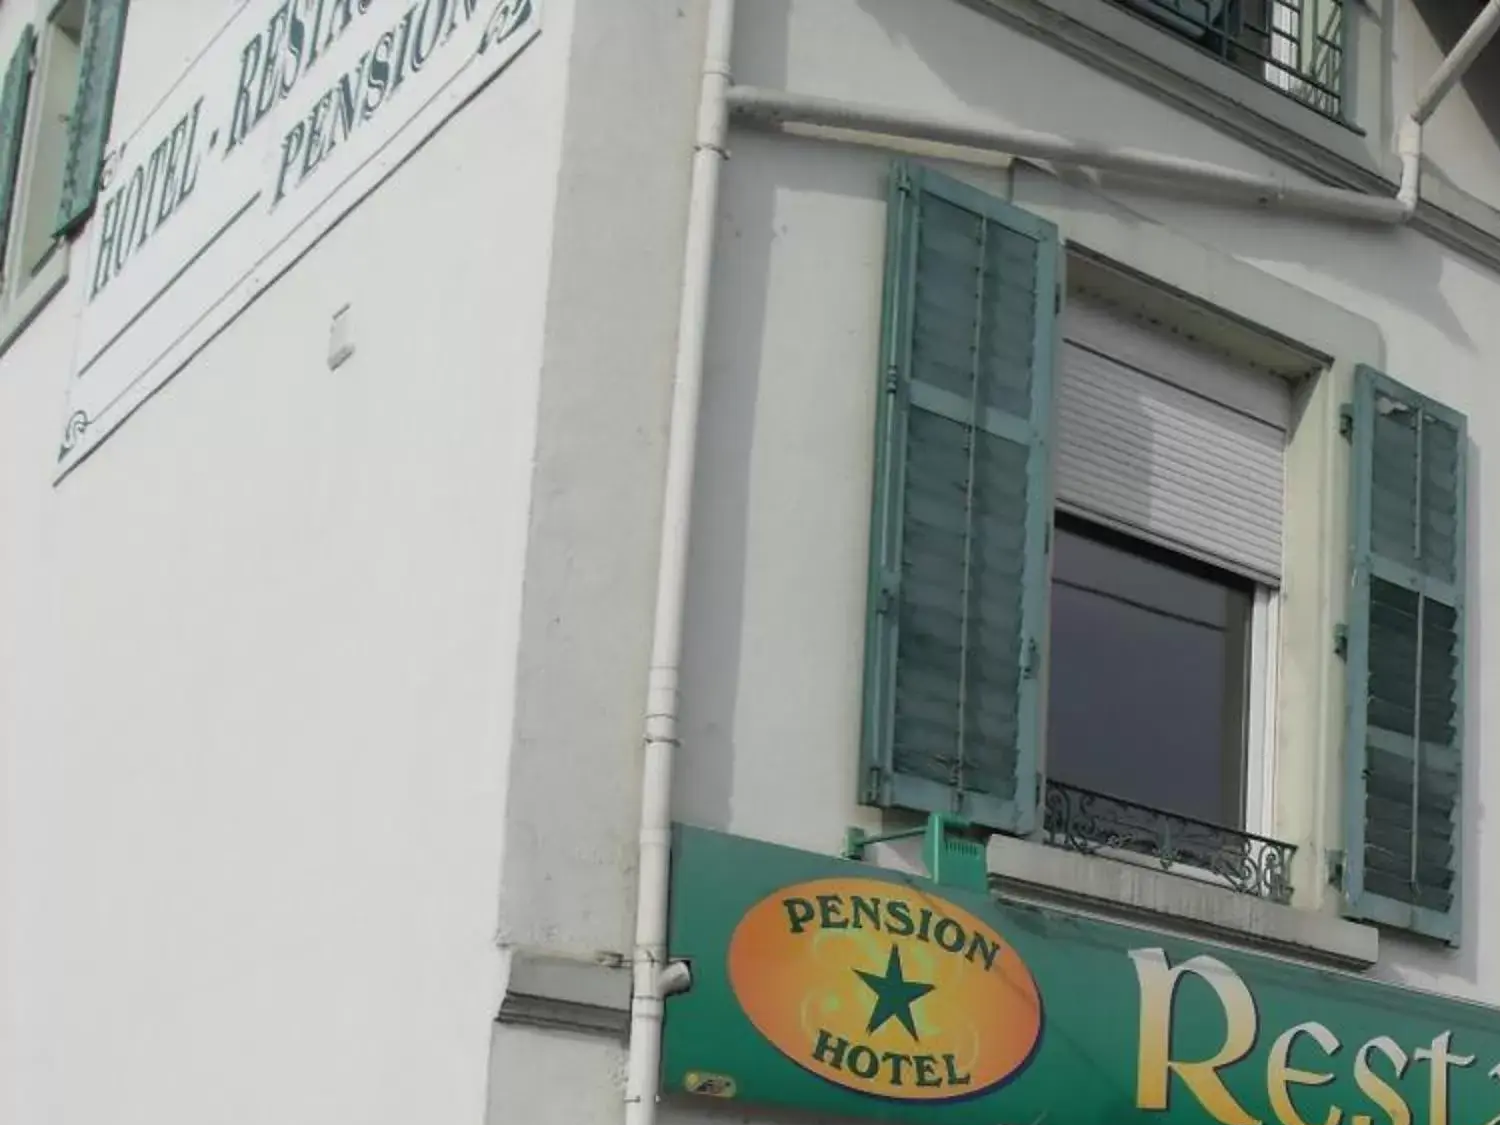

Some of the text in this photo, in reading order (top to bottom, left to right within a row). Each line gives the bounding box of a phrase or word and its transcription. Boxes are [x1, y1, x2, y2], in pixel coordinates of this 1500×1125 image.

[90, 0, 374, 303] HOTEL REST
[782, 894, 1001, 972] PENSION
[811, 1029, 973, 1089] HOTEL
